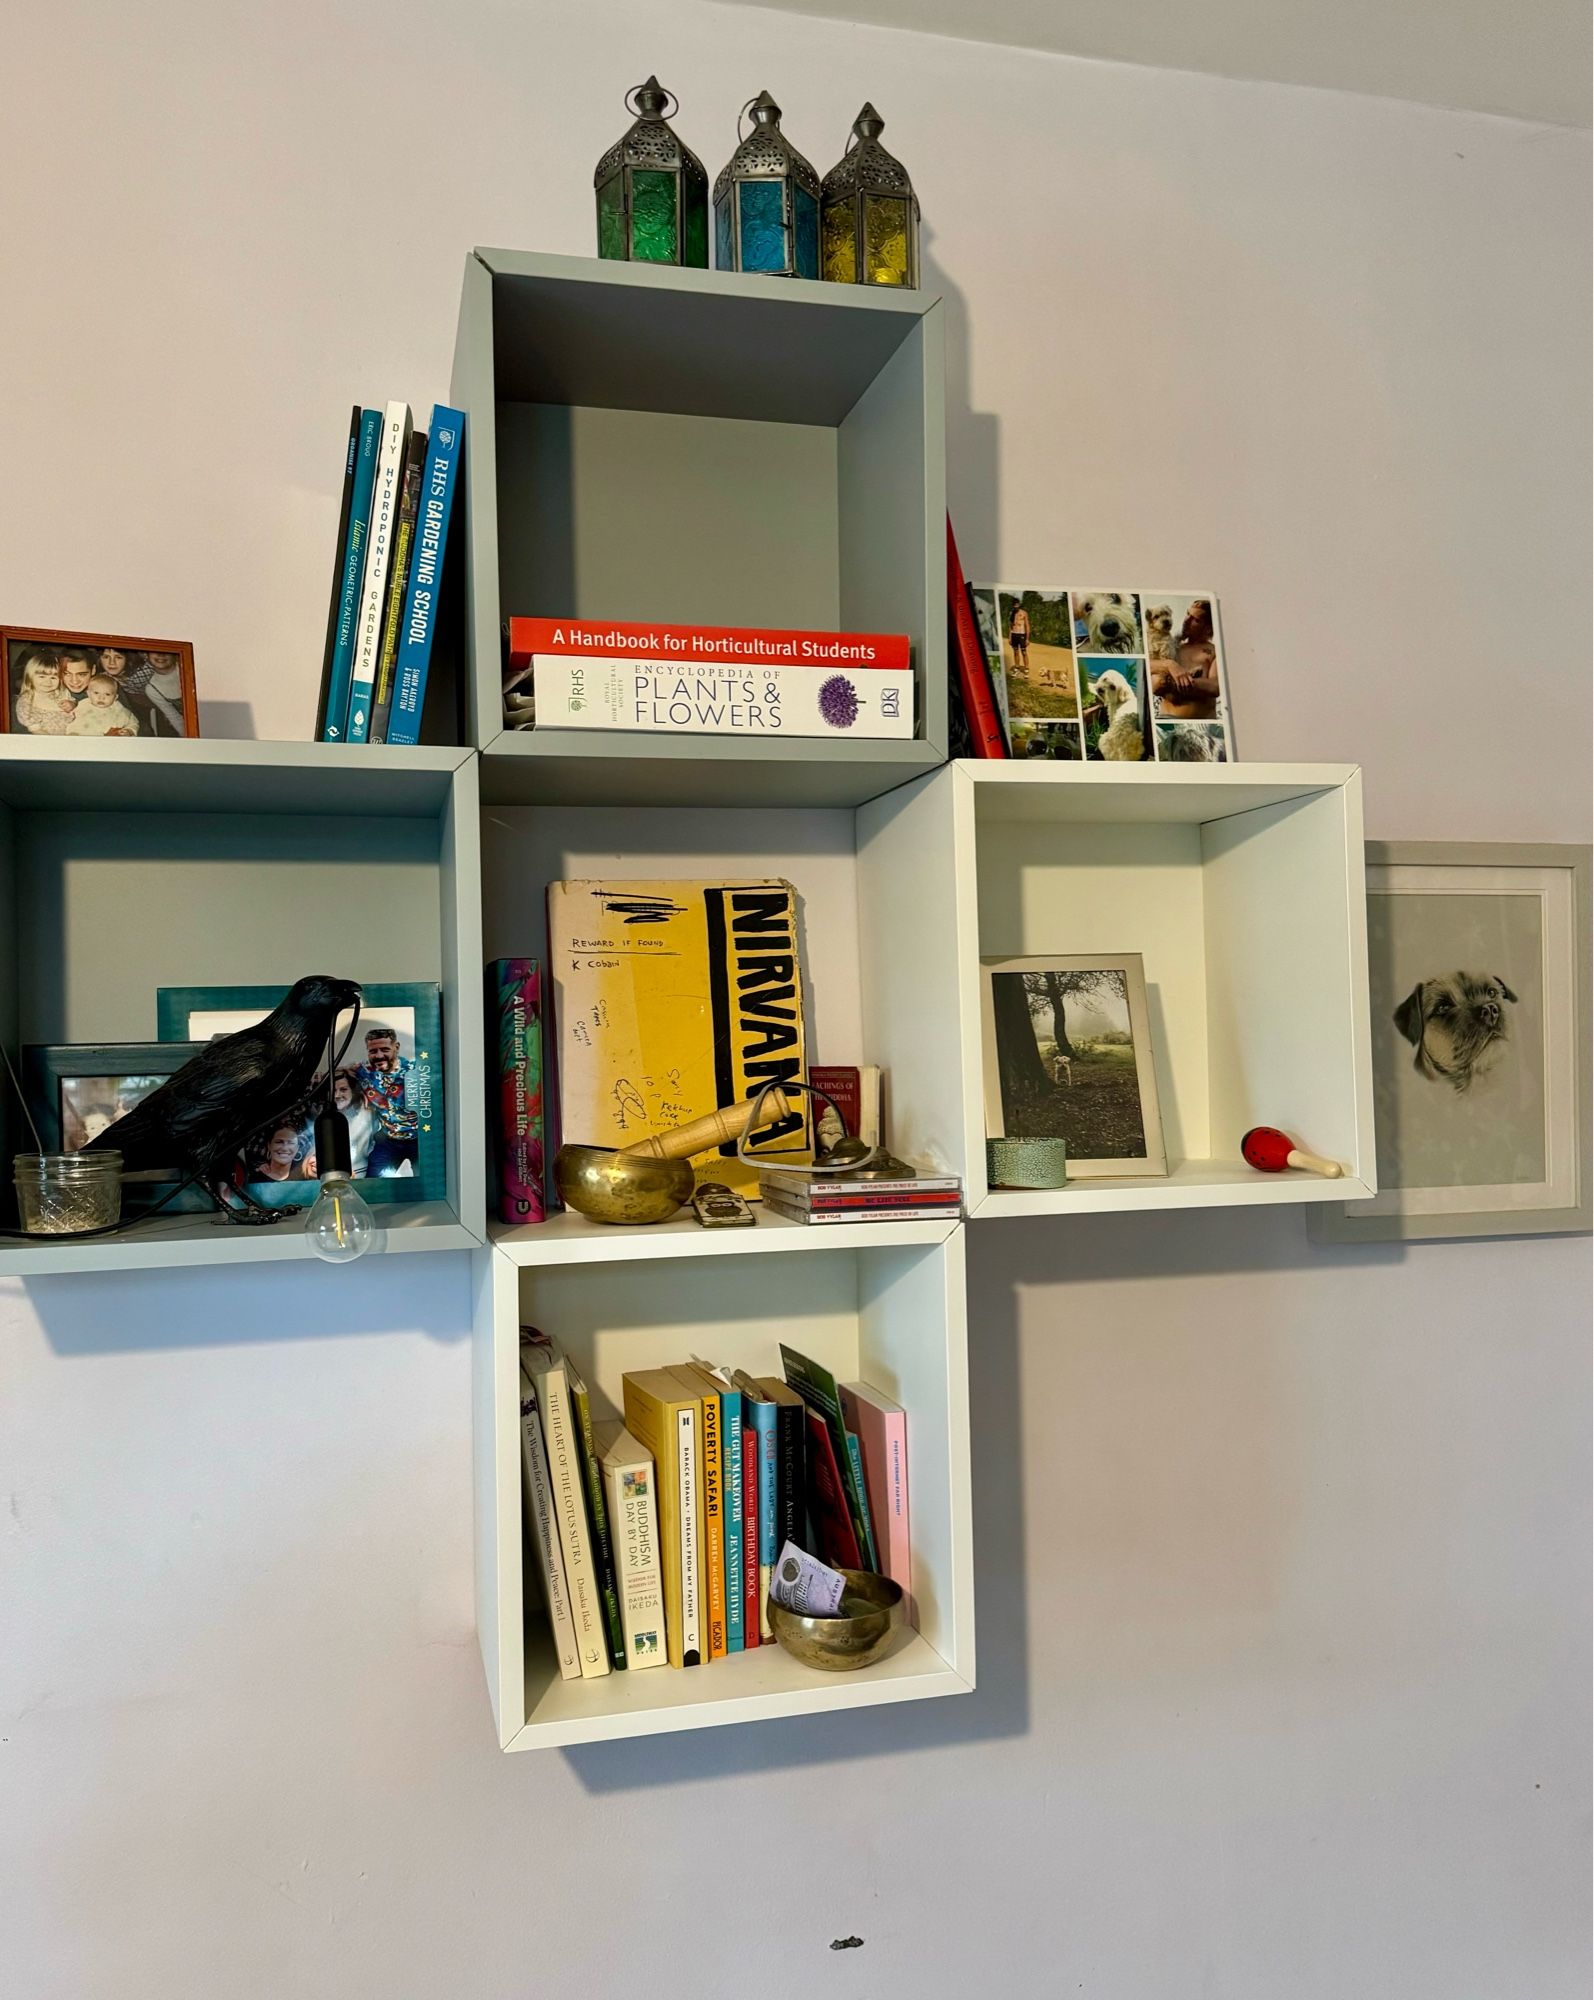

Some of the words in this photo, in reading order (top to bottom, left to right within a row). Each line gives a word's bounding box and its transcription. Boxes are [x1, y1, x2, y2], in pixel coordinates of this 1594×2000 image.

[391, 424, 400, 454] DIY
[430, 456, 450, 496] RHS
[352, 519, 366, 552] Islamic
[374, 468, 394, 577] HYDROPONIC
[417, 500, 444, 585] GARDENING
[345, 555, 358, 604] GEOMETRIC
[340, 607, 352, 646] PATTERNS
[362, 592, 378, 668] GARDENS
[408, 590, 432, 645] SCHOOL
[552, 628, 565, 644] A
[570, 630, 660, 650] Handbook
[664, 634, 688, 650] for
[692, 636, 798, 656] Horticultural
[802, 641, 876, 660] Students
[411, 668, 420, 687] SIMON
[572, 669, 584, 696] RHS
[634, 664, 754, 679] ENCYCLOPEDIA
[763, 670, 781, 680] OF
[635, 676, 755, 702] PLANTS
[764, 682, 782, 704] &
[882, 688, 899, 717] DK
[636, 701, 782, 728] FLOWERS
[572, 938, 614, 948] REWARD
[638, 939, 664, 948] FOUND
[572, 960, 580, 972] K
[514, 995, 524, 1006] A
[514, 1007, 525, 1034] Wild
[732, 892, 804, 1148] NIRVANA
[514, 1037, 525, 1059] and
[406, 1078, 418, 1107] MERRY
[418, 1065, 432, 1118] CHRISTMAS
[515, 1060, 526, 1112] Precious
[516, 1114, 526, 1136] Life
[550, 1393, 560, 1415] THE
[526, 1420, 534, 1436] The
[553, 1416, 566, 1453] HEART
[706, 1404, 717, 1464] POVERTY
[731, 1416, 740, 1438] THE
[784, 1411, 792, 1442] FRANK
[528, 1437, 541, 1471] Wisdom
[558, 1454, 567, 1468] OF
[732, 1440, 741, 1458] GUT
[534, 1472, 542, 1481] for
[561, 1469, 572, 1494] THE
[536, 1482, 548, 1518] Creating
[708, 1470, 718, 1517] SAFARI
[732, 1463, 742, 1522] MAKEOVER
[564, 1495, 576, 1529] LOTUS
[626, 1502, 635, 1524] DAY
[786, 1500, 796, 1540] ANGELA'
[541, 1518, 554, 1558] Happiness
[569, 1530, 582, 1566] SUTRA
[628, 1530, 637, 1544] BY
[637, 1500, 652, 1566] BUDDHISM
[748, 1516, 756, 1566] BIRTHDAY
[548, 1558, 557, 1574] and
[629, 1546, 639, 1568] DAY
[730, 1535, 739, 1594] JEANNETTE
[576, 1577, 588, 1609] Daisaku
[687, 1575, 693, 1586] MY
[748, 1568, 756, 1598] BOOK
[555, 1600, 564, 1616] Part
[628, 1594, 658, 1603] DAISAKU
[628, 1600, 659, 1610] IKEDA
[731, 1594, 740, 1624] HYDE
[582, 1610, 592, 1632] Ikeda
[712, 1620, 722, 1650] PICADOR
